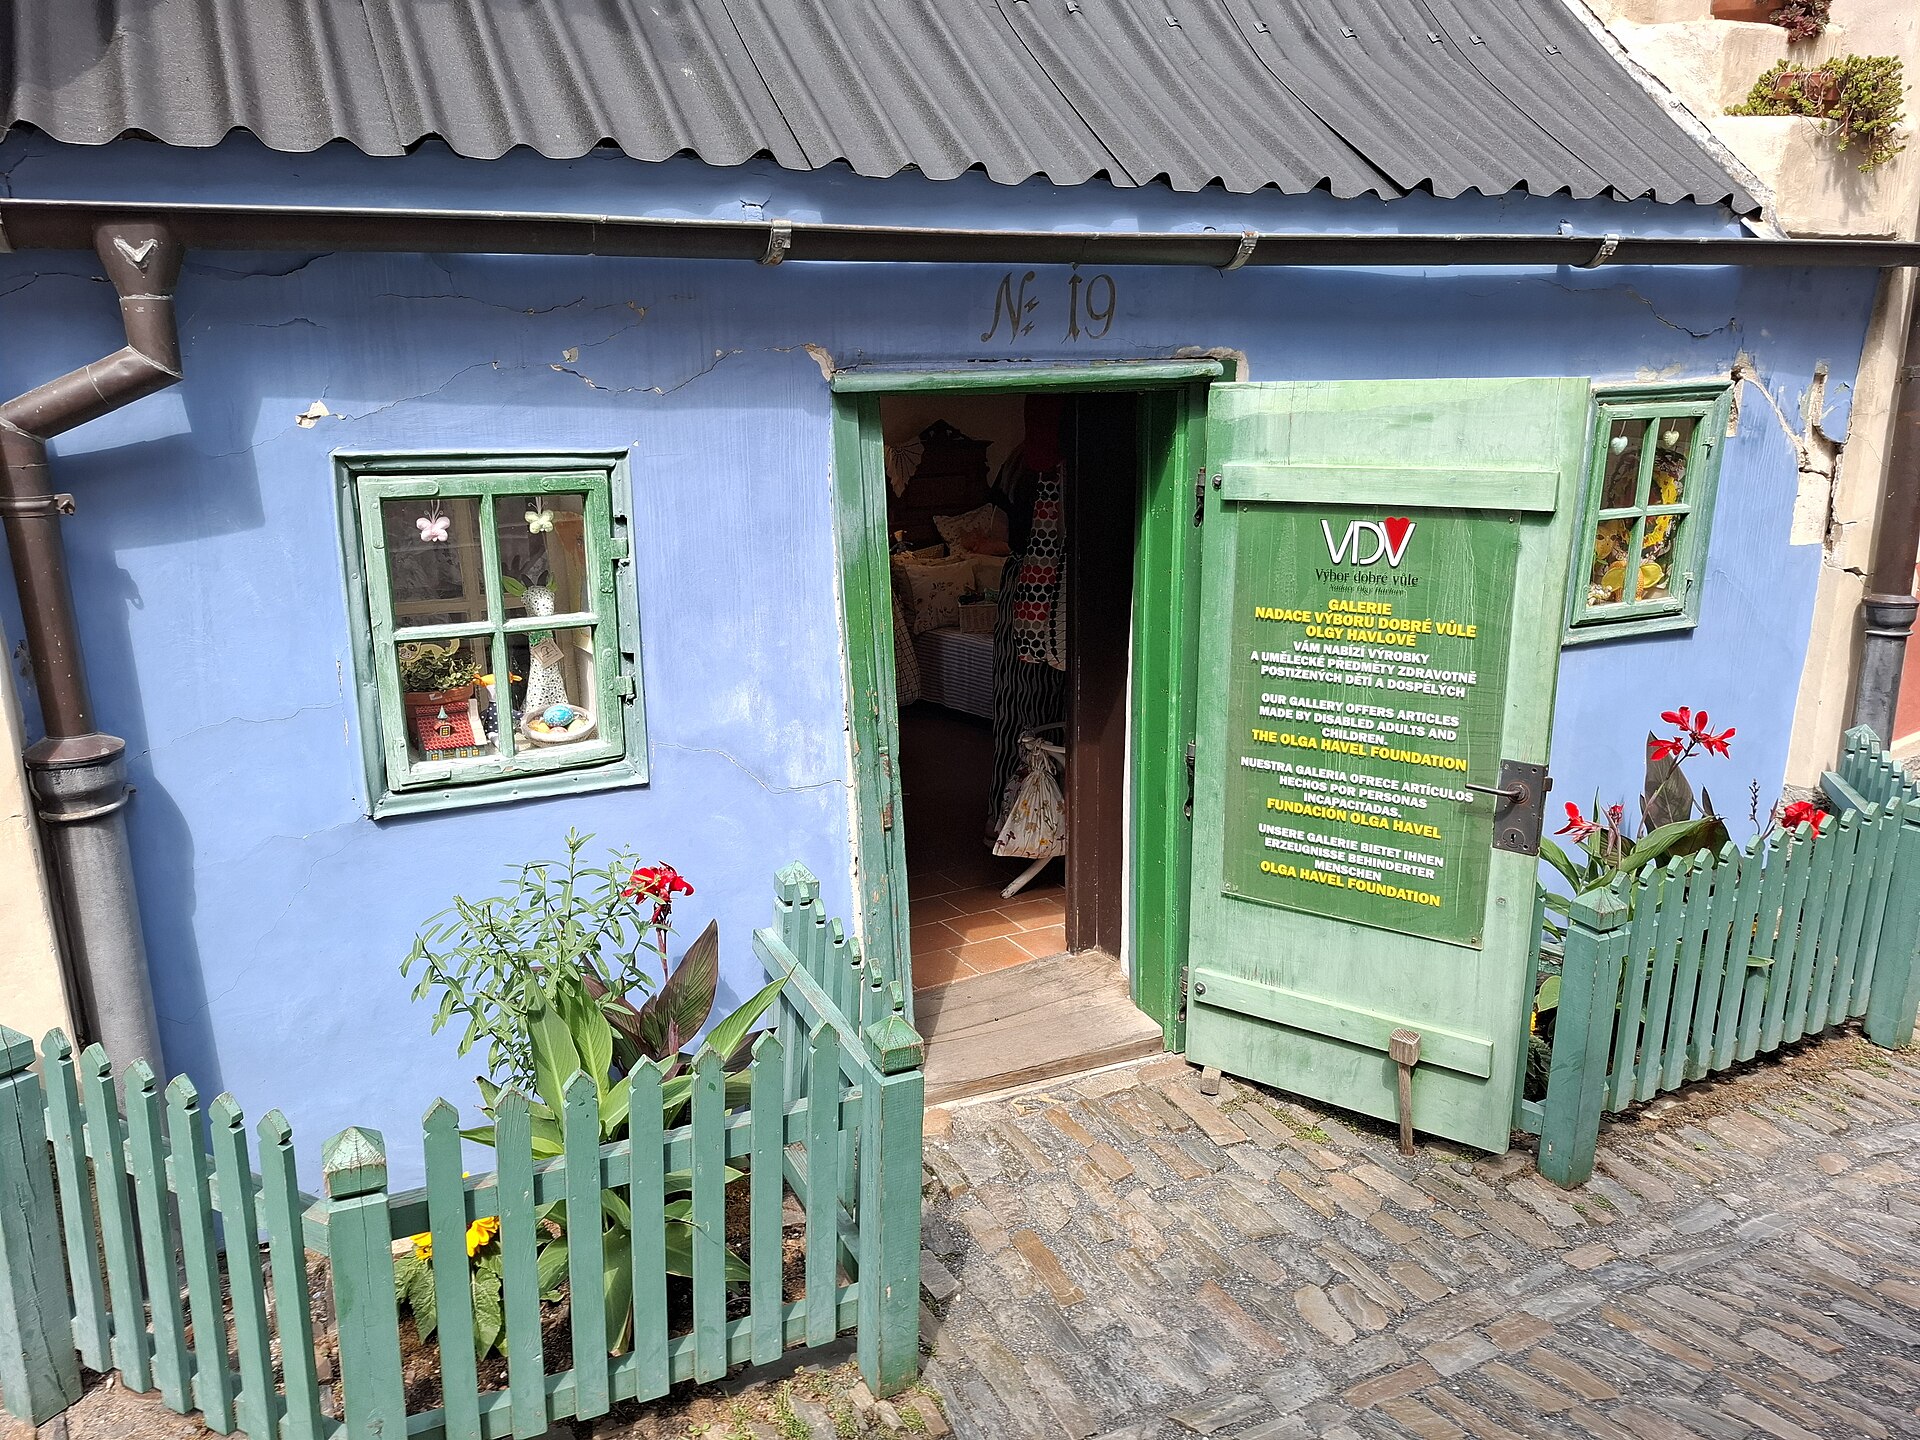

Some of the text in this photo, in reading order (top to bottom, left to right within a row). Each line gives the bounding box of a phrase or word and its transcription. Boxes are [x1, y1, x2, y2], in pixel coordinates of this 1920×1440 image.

[1061, 264, 1116, 344] 19
[1320, 519, 1417, 568] VDV
[1315, 568, 1419, 588] Výbor dobré vůle
[1255, 606, 1477, 638] NADACE VÝBORU DOBRÉ VŮLE
[1328, 599, 1392, 616] GALERIE
[1293, 640, 1430, 664] VÁM NABÍZÍ VÝROBKY
[1305, 625, 1417, 647] OLGY HAVLOVÉ
[1250, 650, 1477, 685] A UMĚLECKÉ PŘEDMĚTY ZDRAVOTNĚ
[1260, 664, 1466, 698] POSTIŽENÝCH DĚTÍ A DOSPĚLÝCH
[1259, 705, 1457, 741] MADE BY DISABLED ADULTS AND
[1261, 693, 1460, 727] OUR GALLERY OFFERS ARTICLES
[1251, 729, 1467, 771] THE OLGA HAVEL FOUNDATION
[1321, 727, 1389, 746] CHILDREN.
[1240, 756, 1474, 803] NUESTRA GALERIA OFRECE ARTÍCULOS
[1279, 775, 1428, 809] HECHOS POR PERSONAS
[1266, 797, 1441, 839] FUNDACIÓN OLGA HAVEL
[1303, 792, 1402, 819] INCAPACITADAS.
[1258, 822, 1444, 868] UNSERE GALERIE BIETET IHNEN
[1264, 836, 1435, 880] ERZEUGNISSE BEHINDERTER
[1260, 860, 1441, 907] OLGA HAVEL FOUNDATION
[1314, 859, 1382, 882] MENSCHEN
